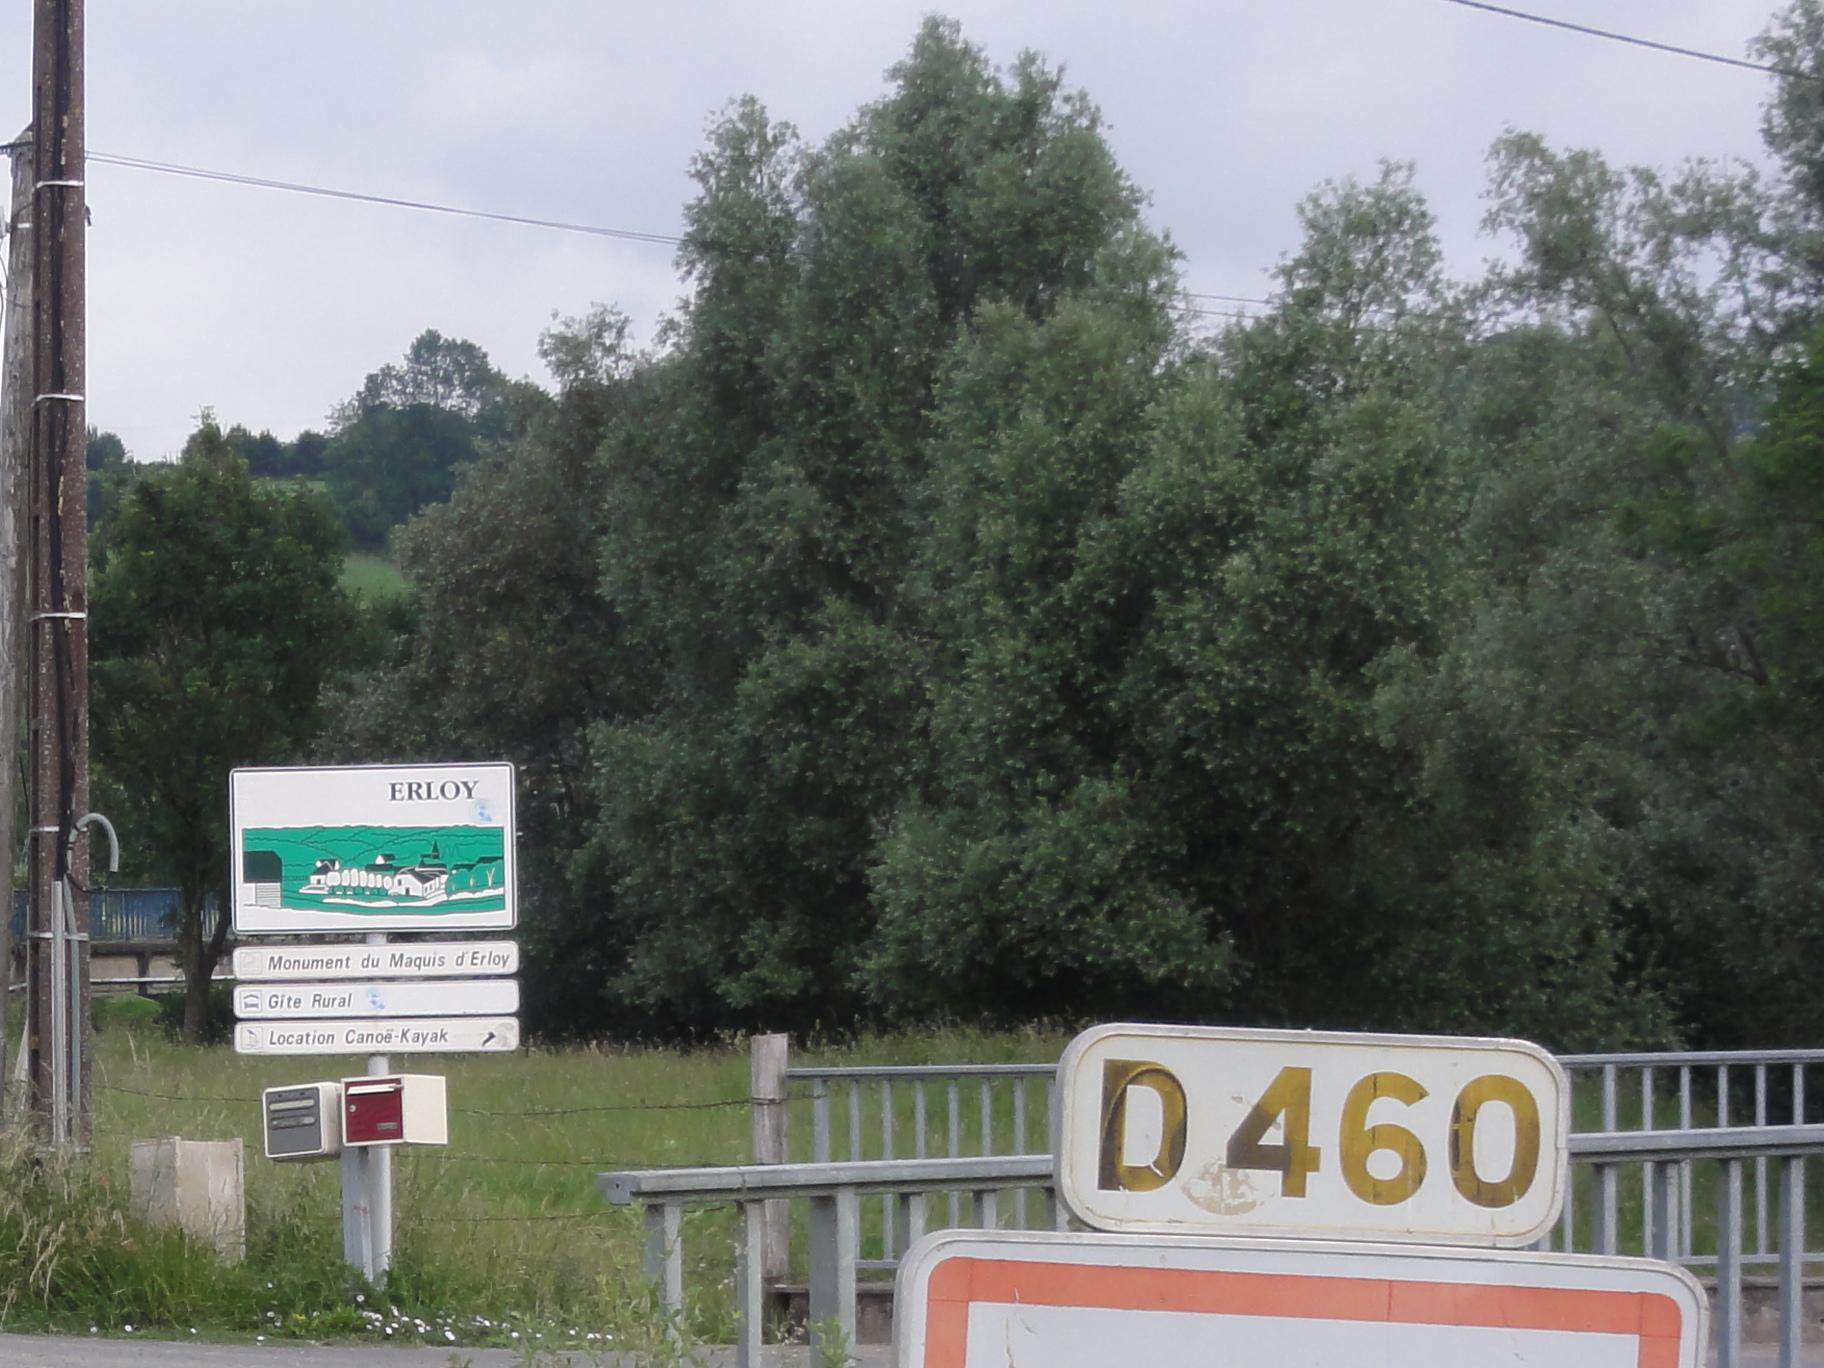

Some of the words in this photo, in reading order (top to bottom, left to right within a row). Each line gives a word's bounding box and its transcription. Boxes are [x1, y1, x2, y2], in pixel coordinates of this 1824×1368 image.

[389, 780, 479, 801] ERLOY
[268, 954, 351, 971] Monument
[361, 954, 380, 968] du
[389, 953, 446, 969] Maquis
[312, 993, 352, 1009] Rural
[269, 1030, 335, 1045] Location
[345, 1028, 448, 1046] Canoë-Kayak
[1097, 1058, 1188, 1192] D
[1226, 1066, 1542, 1208] 460
